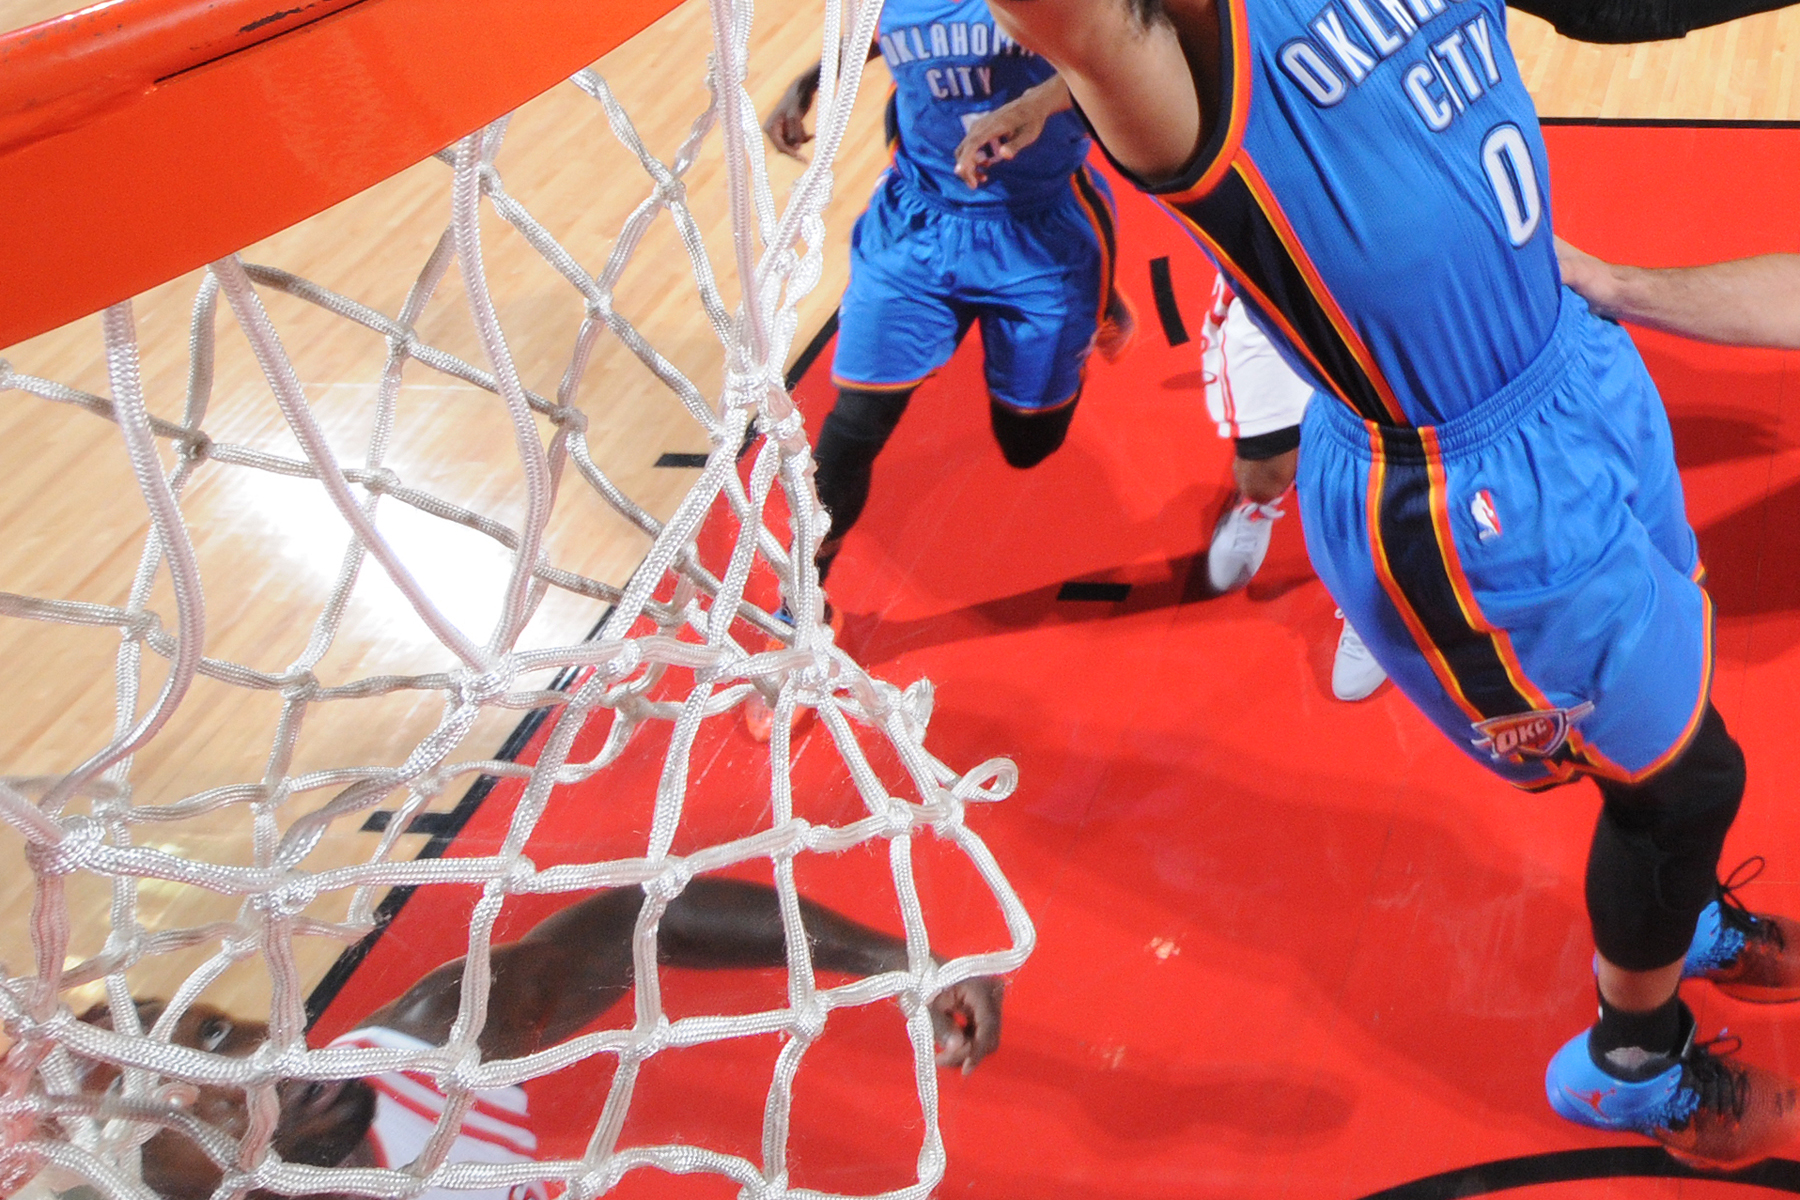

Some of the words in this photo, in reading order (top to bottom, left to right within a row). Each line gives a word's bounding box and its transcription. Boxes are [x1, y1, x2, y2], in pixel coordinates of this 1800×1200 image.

[926, 65, 992, 99] CITY
[1401, 10, 1502, 133] CITY
[1480, 120, 1542, 249] 0
[1496, 717, 1548, 754] OKC
